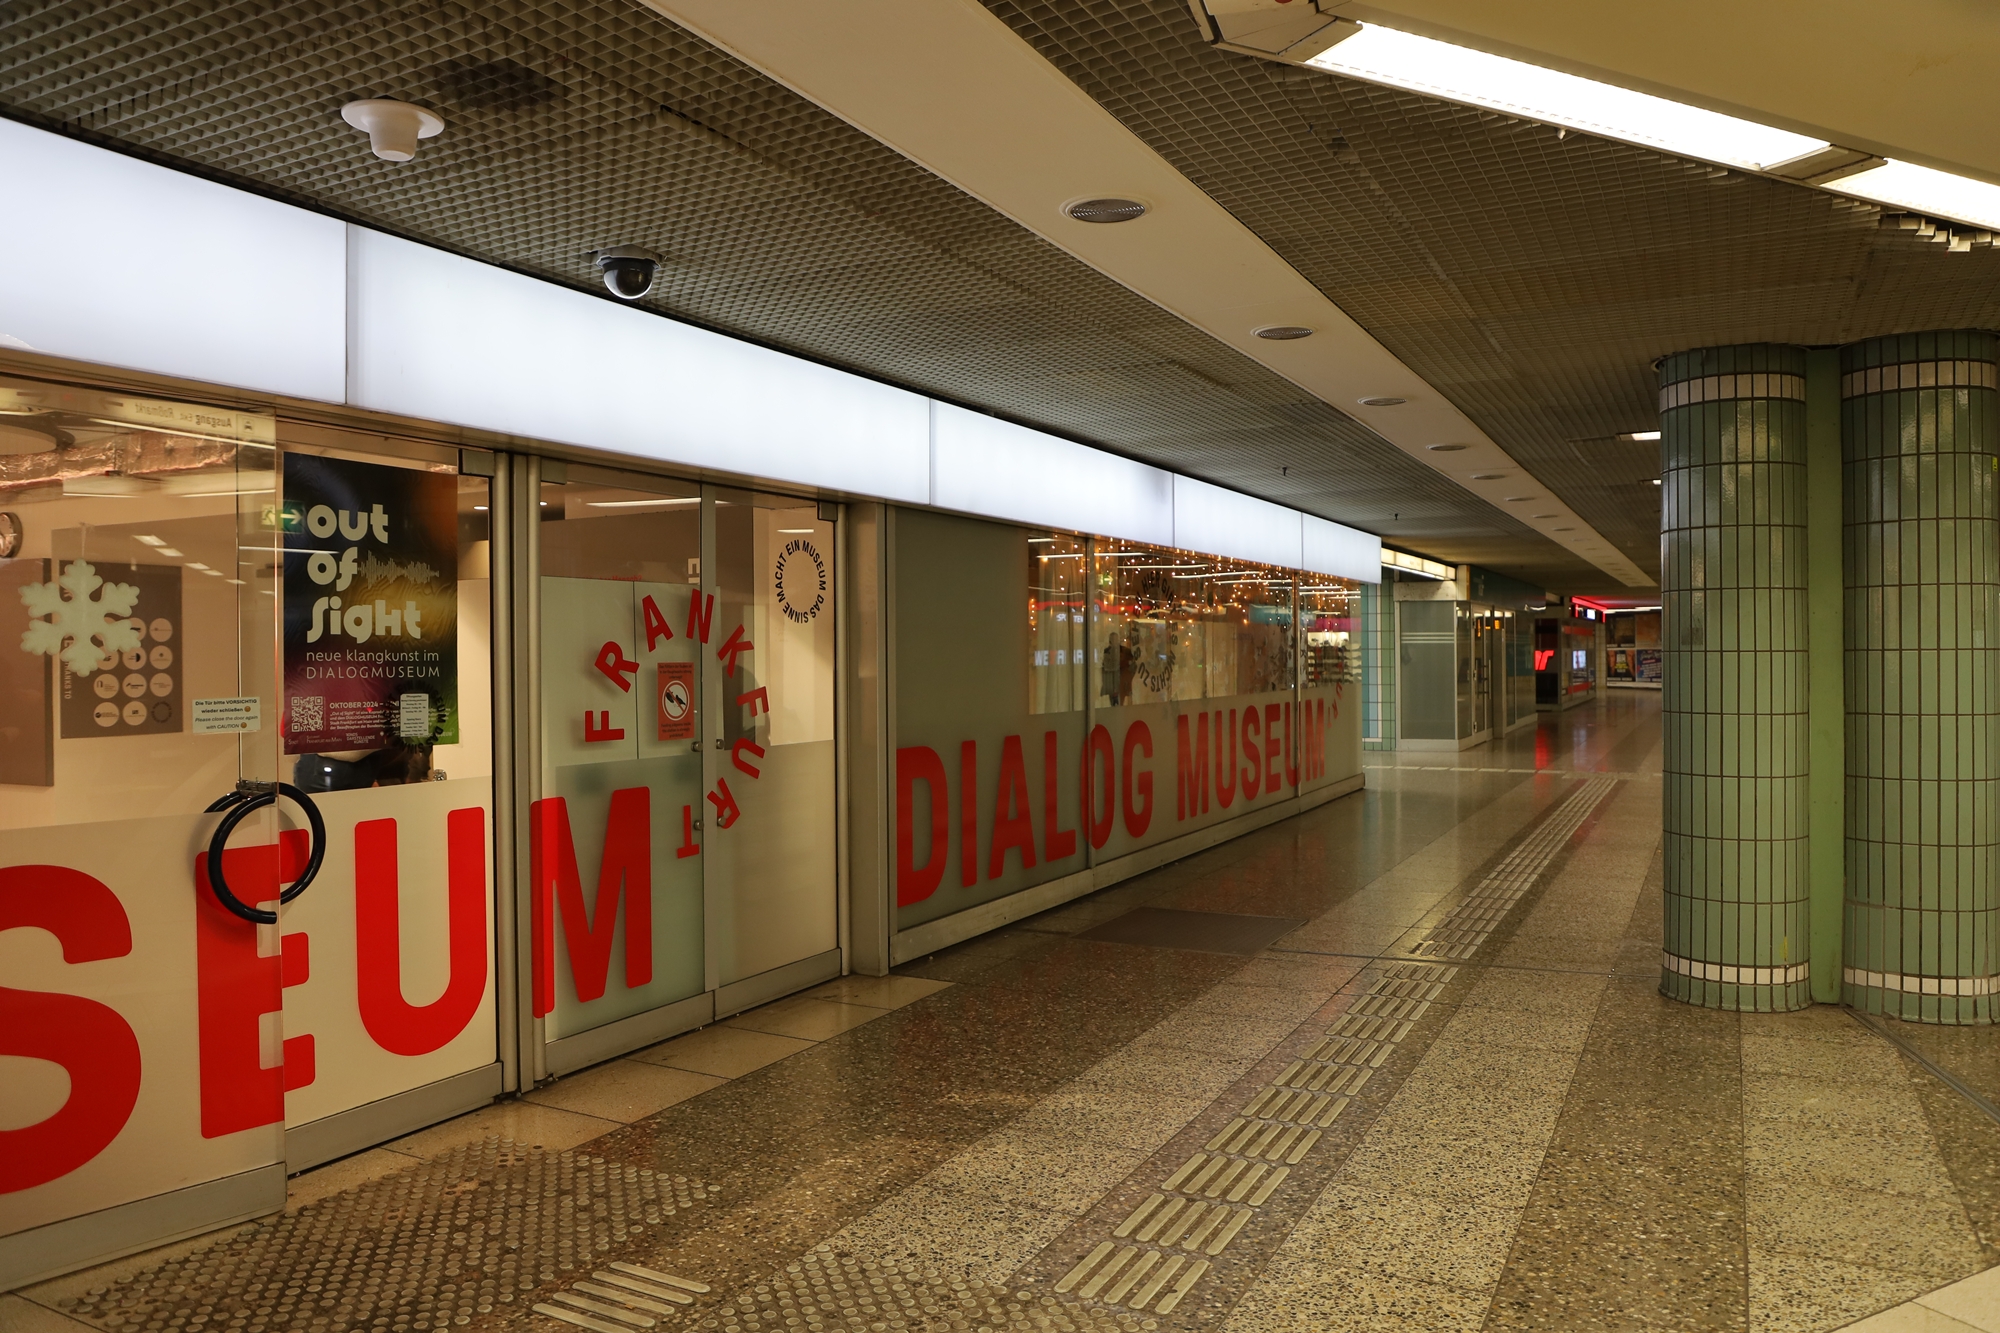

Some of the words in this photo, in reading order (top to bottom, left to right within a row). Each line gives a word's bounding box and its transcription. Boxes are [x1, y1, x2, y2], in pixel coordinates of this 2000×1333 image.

[785, 539, 800, 556] EIN
[307, 546, 358, 592] of
[775, 552, 787, 603] MACHT
[802, 540, 826, 591] MUSEUM
[782, 602, 809, 624] SINNE
[810, 594, 824, 618] DAS
[306, 651, 341, 662] neue
[346, 649, 419, 665] klangkunst
[423, 649, 439, 662] im
[307, 666, 441, 679] DIALOGMUSEUM
[329, 701, 362, 709] OKTOBER
[585, 588, 770, 859] FRANKFURT
[1178, 697, 1325, 821] MUSEUM
[897, 720, 1153, 908] DIALOG
